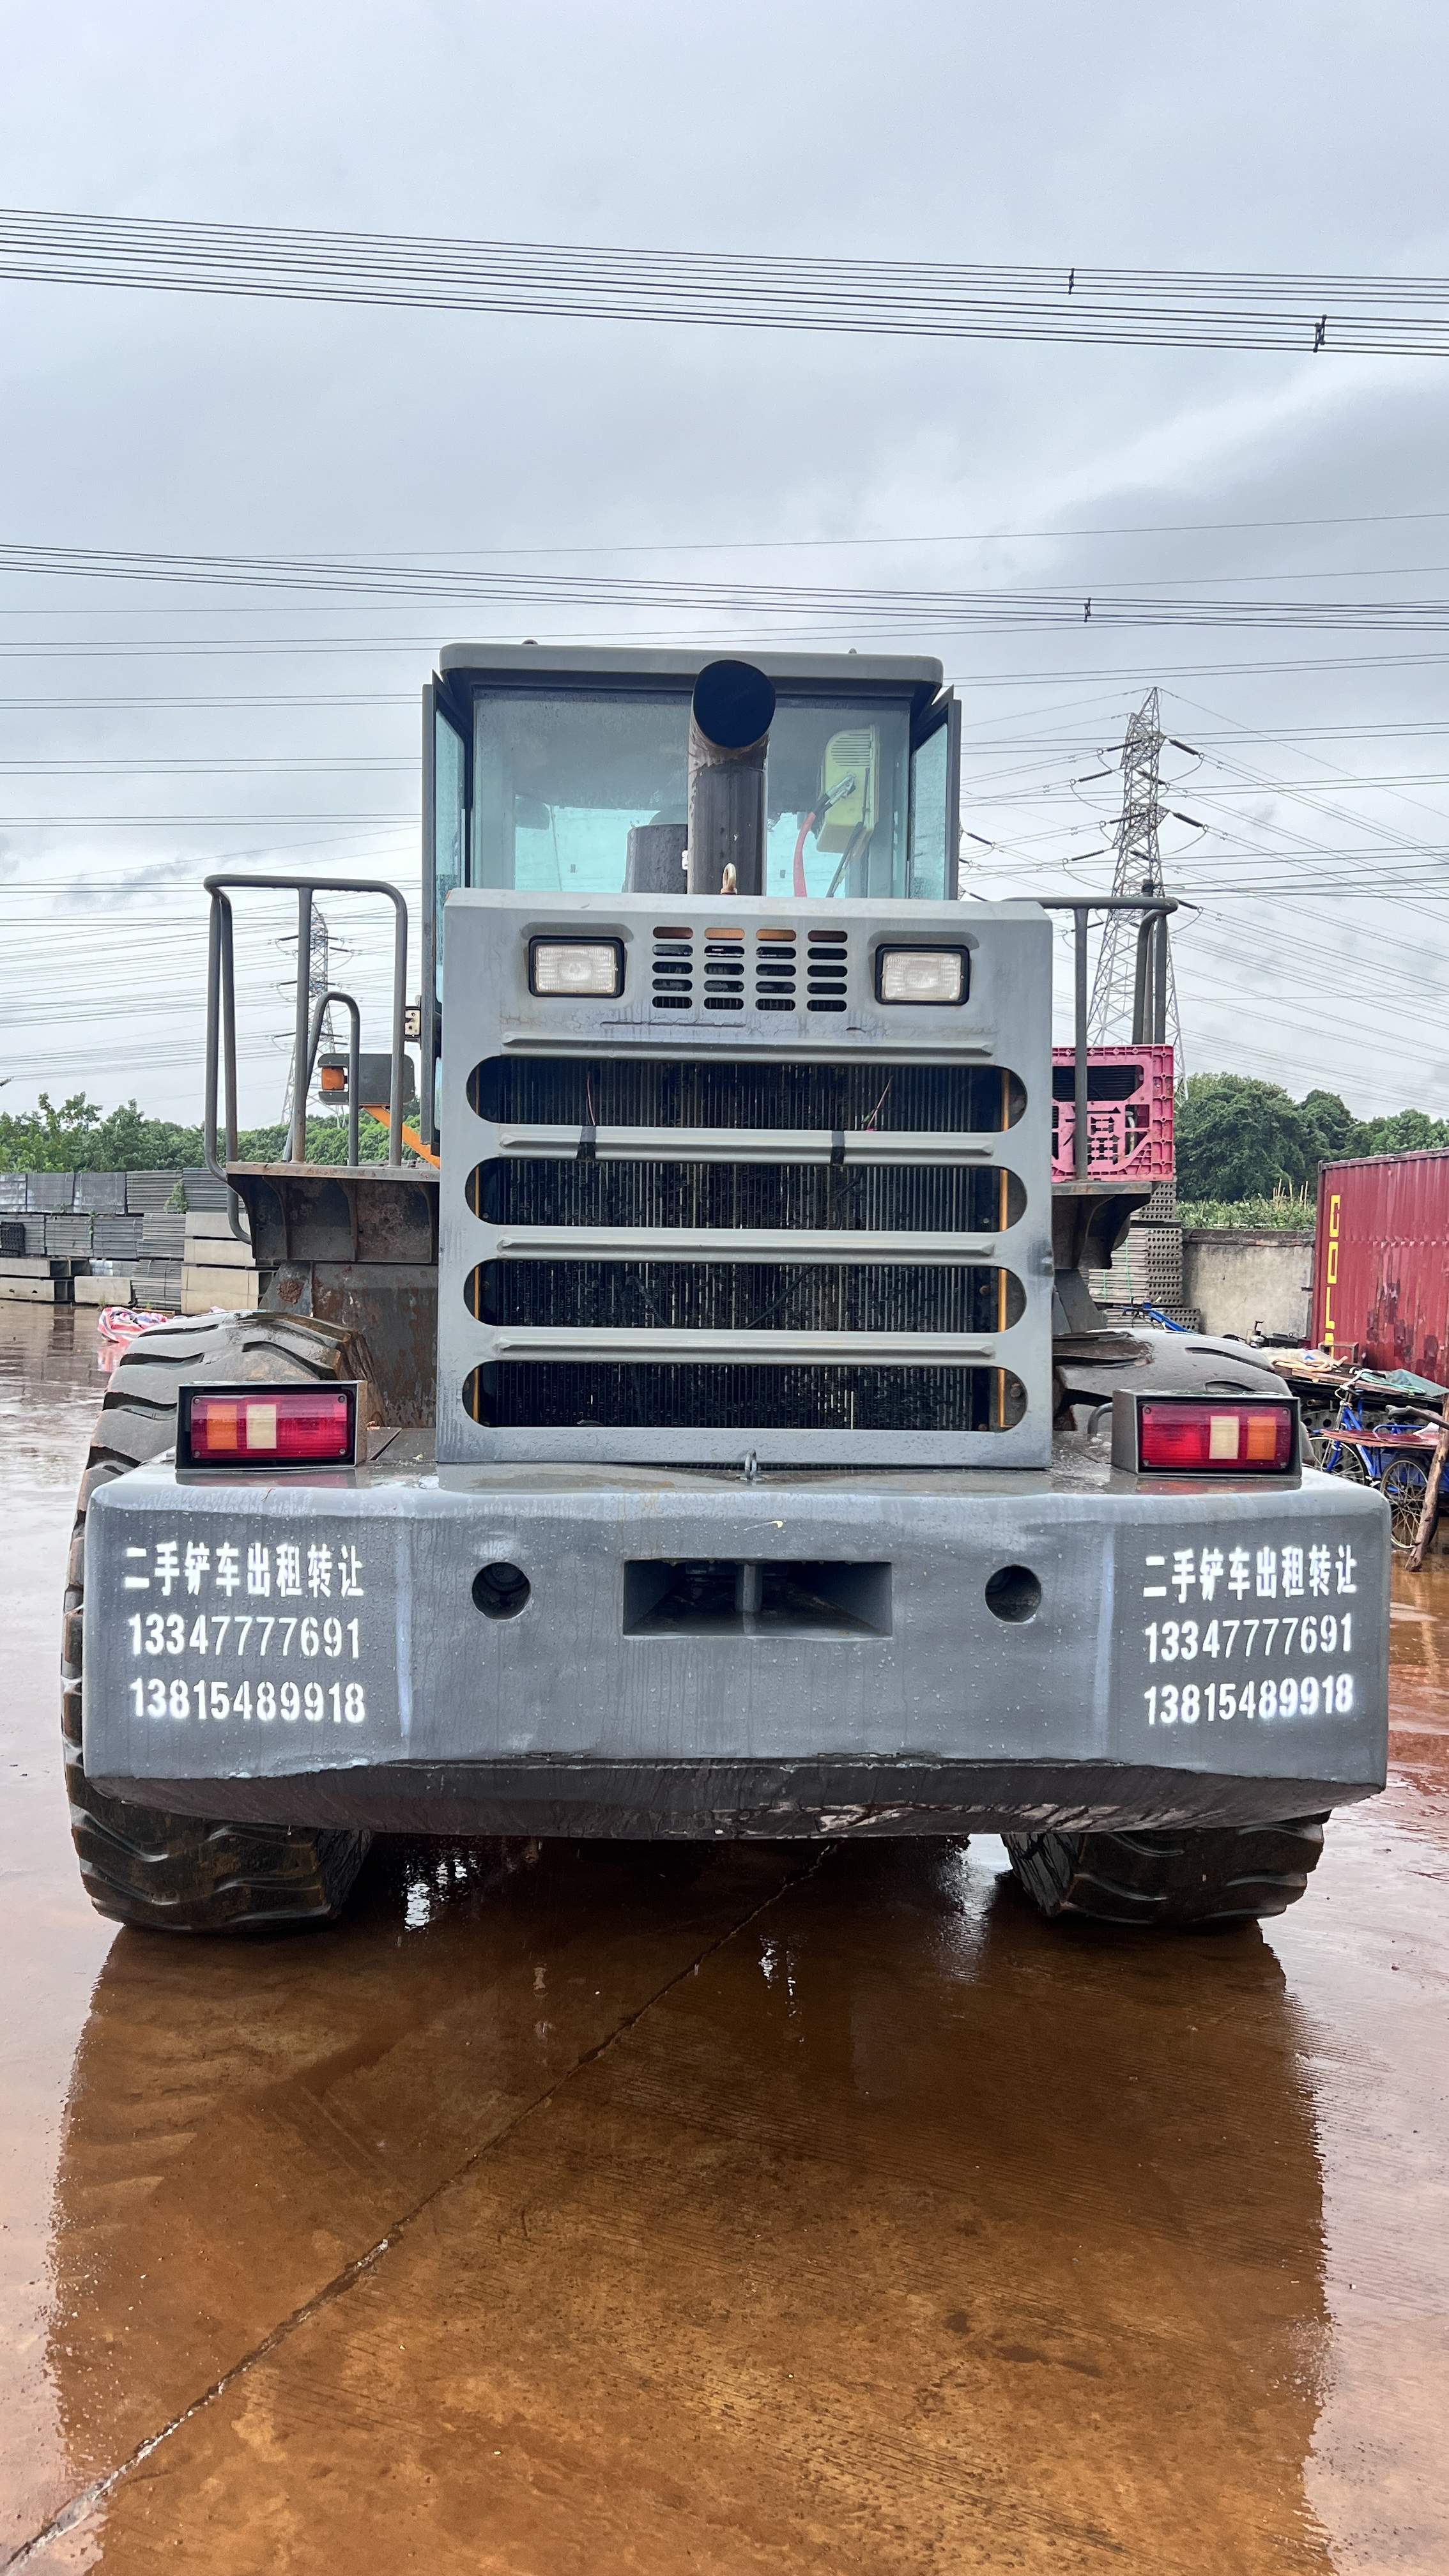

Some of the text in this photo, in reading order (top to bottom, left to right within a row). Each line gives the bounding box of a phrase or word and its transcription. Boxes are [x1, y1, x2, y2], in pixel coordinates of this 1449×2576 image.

[125, 1540, 364, 1598] 二手铲车出租转让
[1143, 1544, 1357, 1603] 二手铲车出租转让
[127, 1613, 359, 1659] 13347777691
[1144, 1613, 1351, 1662] 13347777691
[130, 1677, 365, 1724] 13815489918
[1144, 1673, 1354, 1725] 13815489918
